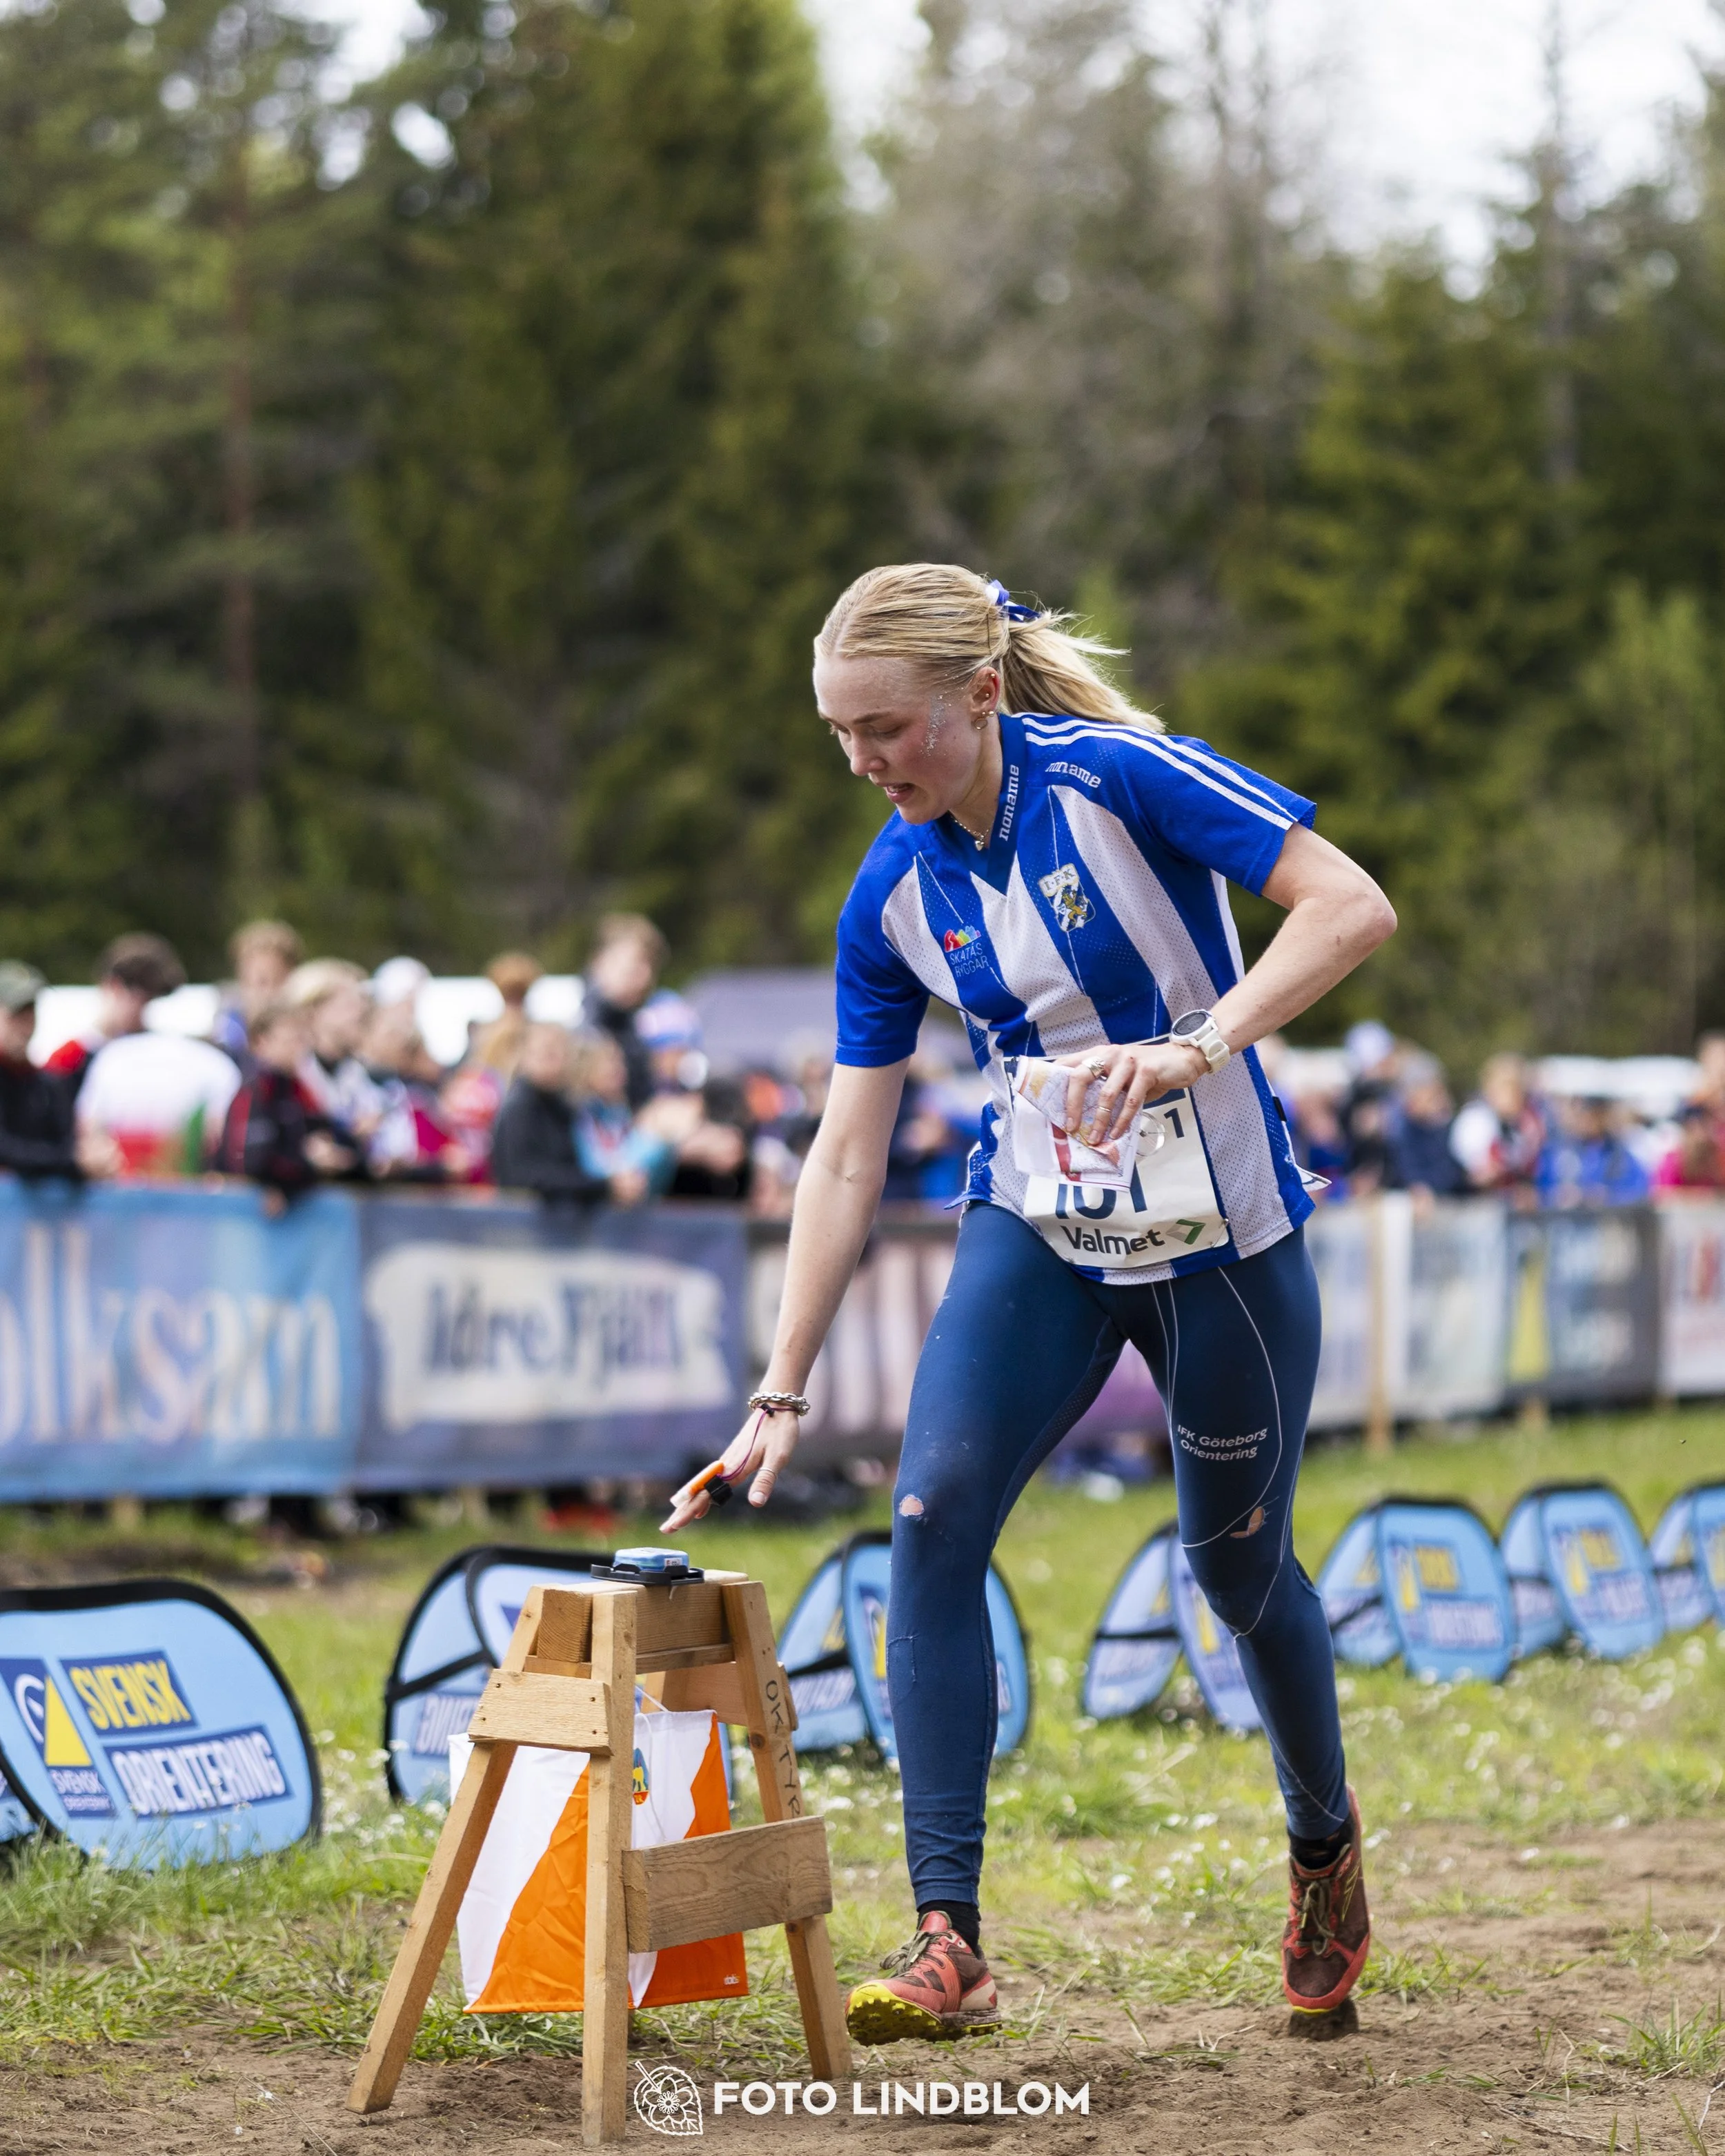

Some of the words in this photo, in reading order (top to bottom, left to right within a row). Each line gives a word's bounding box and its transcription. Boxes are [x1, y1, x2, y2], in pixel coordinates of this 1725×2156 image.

[1045, 761, 1102, 789] noname
[998, 764, 1020, 842] noname
[1163, 1107, 1185, 1138] 1
[1060, 1225, 1166, 1256] Valmet
[1177, 1424, 1196, 1442] IFK
[1199, 1427, 1269, 1448] Göteborg
[1180, 1438, 1259, 1461] Orientering
[70, 1659, 192, 1731] SVENSK
[765, 1680, 785, 1734] OK
[778, 1743, 801, 1815] TYR
[111, 1730, 287, 1815] ORIENTERING
